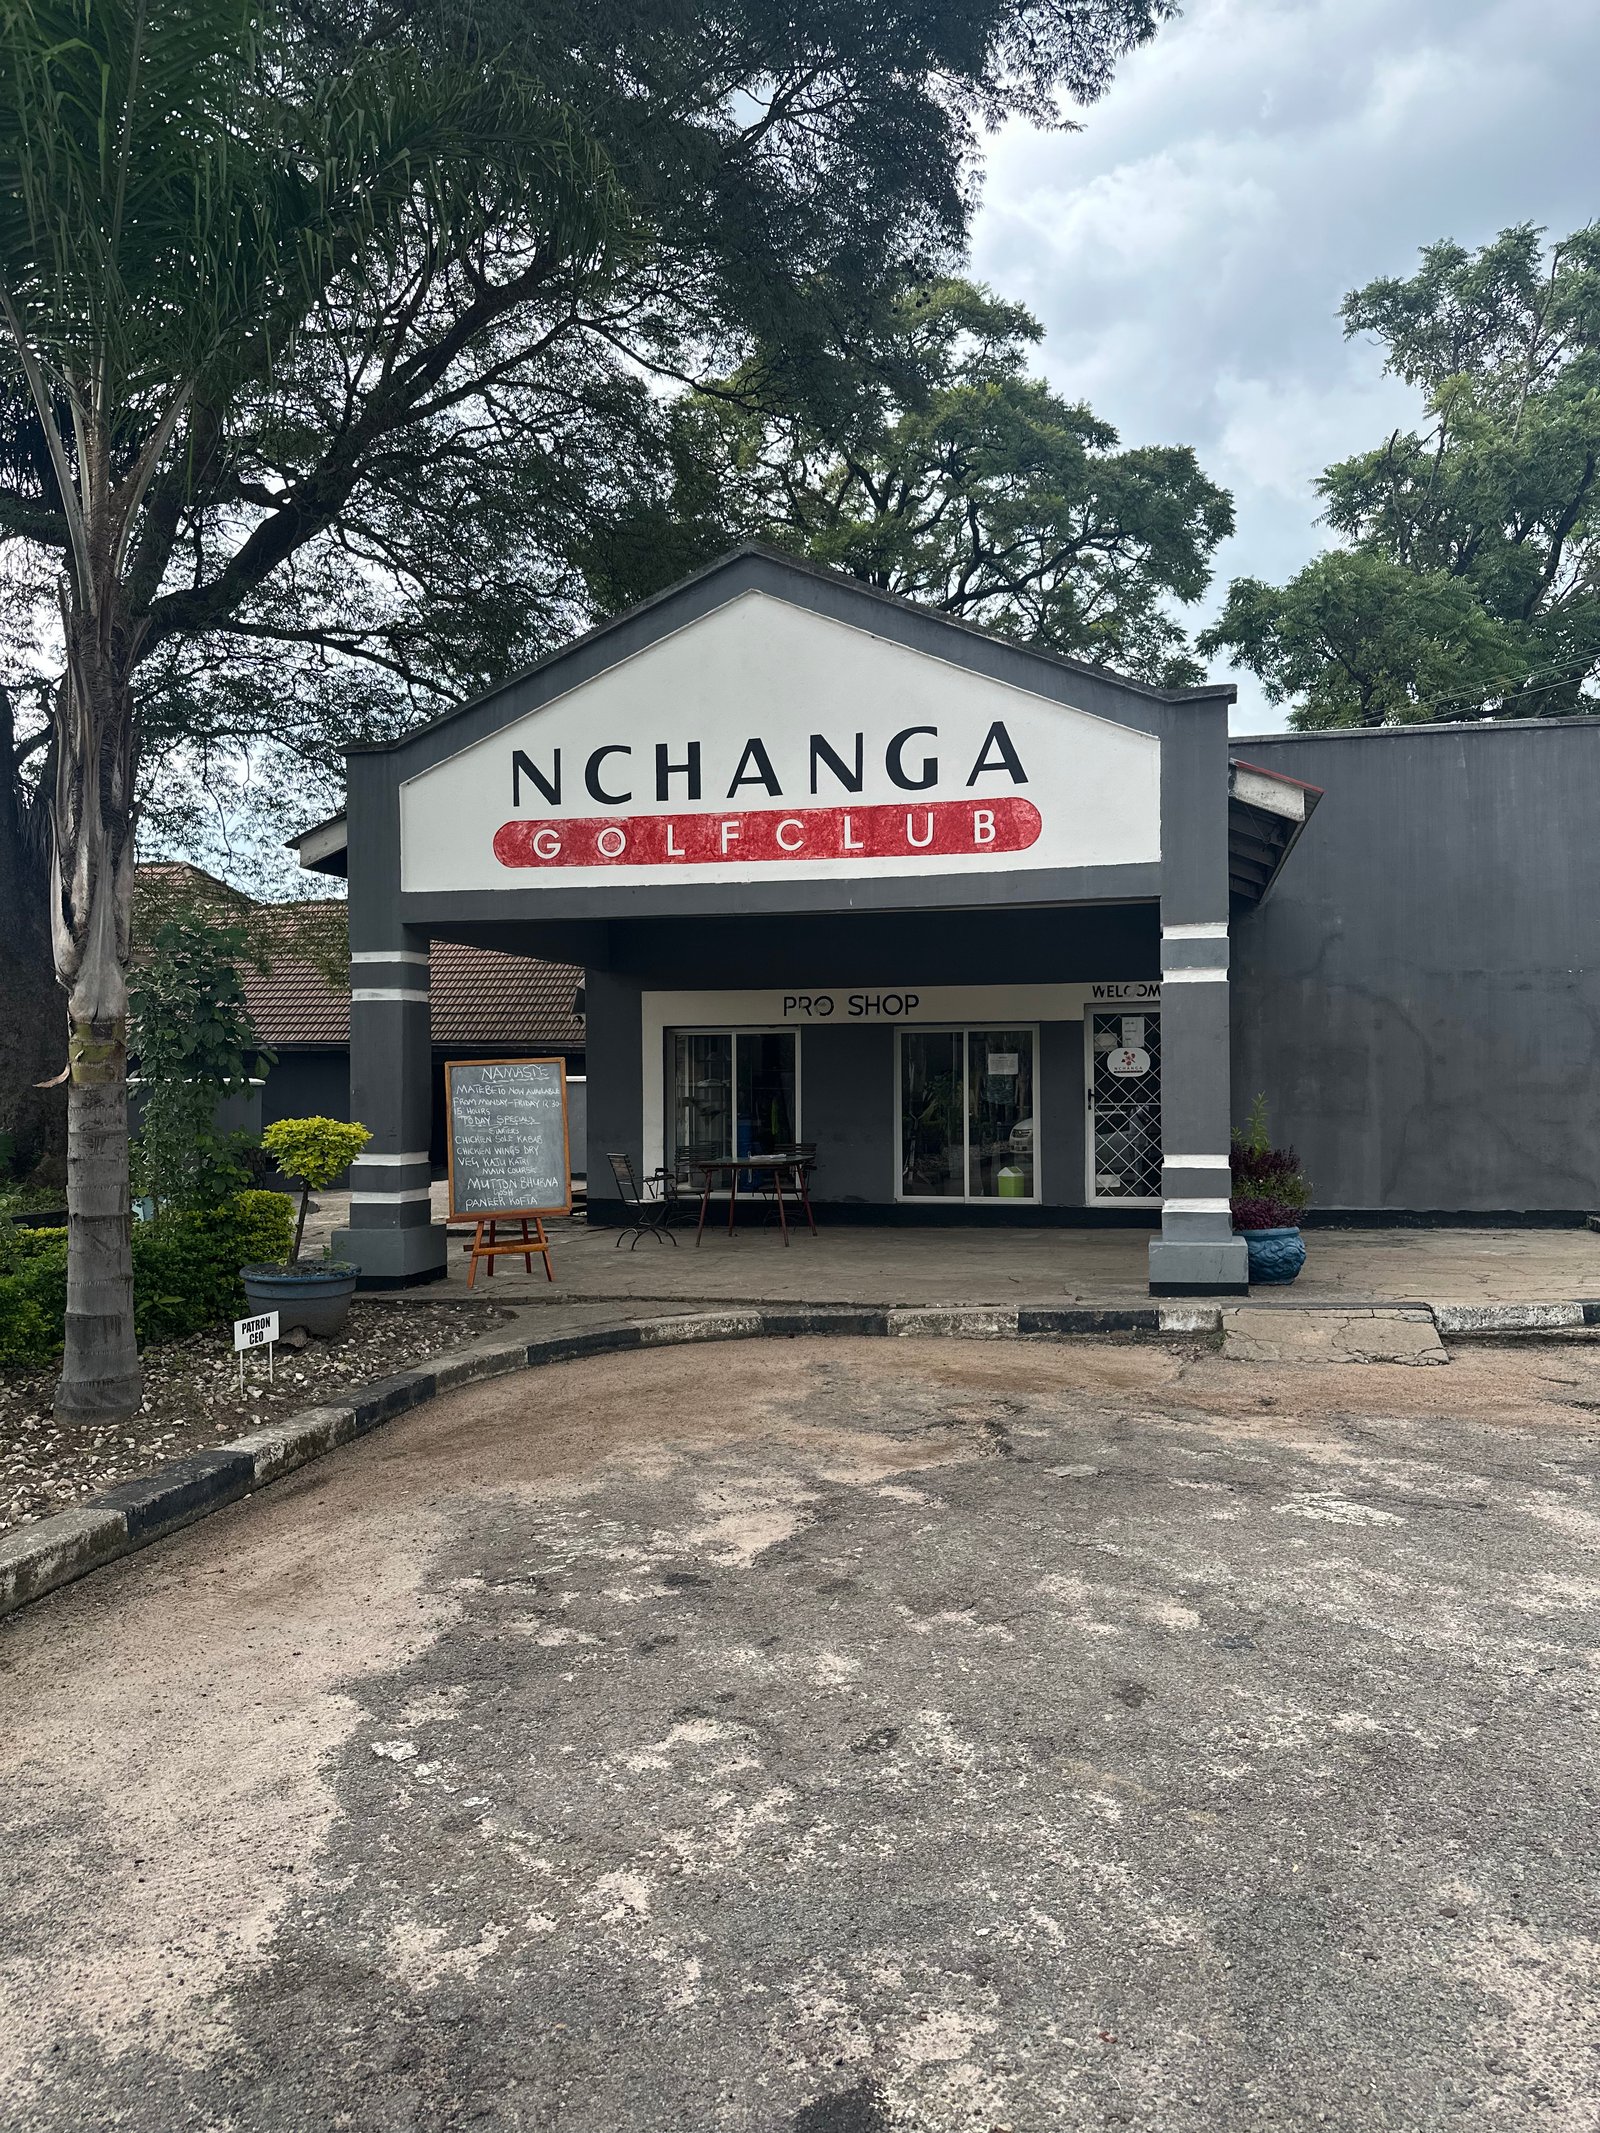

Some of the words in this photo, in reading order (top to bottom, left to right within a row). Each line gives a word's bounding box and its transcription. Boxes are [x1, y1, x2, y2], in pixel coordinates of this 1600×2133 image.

[512, 721, 1028, 807] NCHANGA
[1092, 984, 1160, 998] WELCOM
[784, 995, 835, 1016] PRO
[848, 994, 919, 1016] SHOP
[508, 1087, 525, 1096] NOW
[526, 1087, 561, 1096] AVAILABLE
[453, 1097, 477, 1107] FROM
[467, 1107, 491, 1116] HOURS
[457, 1115, 491, 1126] TODAY
[454, 1135, 492, 1145] CHICKEN
[456, 1147, 491, 1156] CHICKEN
[494, 1146, 520, 1157] WINGS
[523, 1145, 539, 1156] DRY
[458, 1157, 480, 1168] VEG
[482, 1167, 505, 1175] MAIN
[507, 1165, 538, 1175] COURSE
[467, 1177, 518, 1191] MUTTON
[465, 1196, 506, 1212] PANEER
[509, 1194, 538, 1206] KOFTA
[241, 1316, 271, 1334] PATRON
[249, 1331, 264, 1345] CEO
